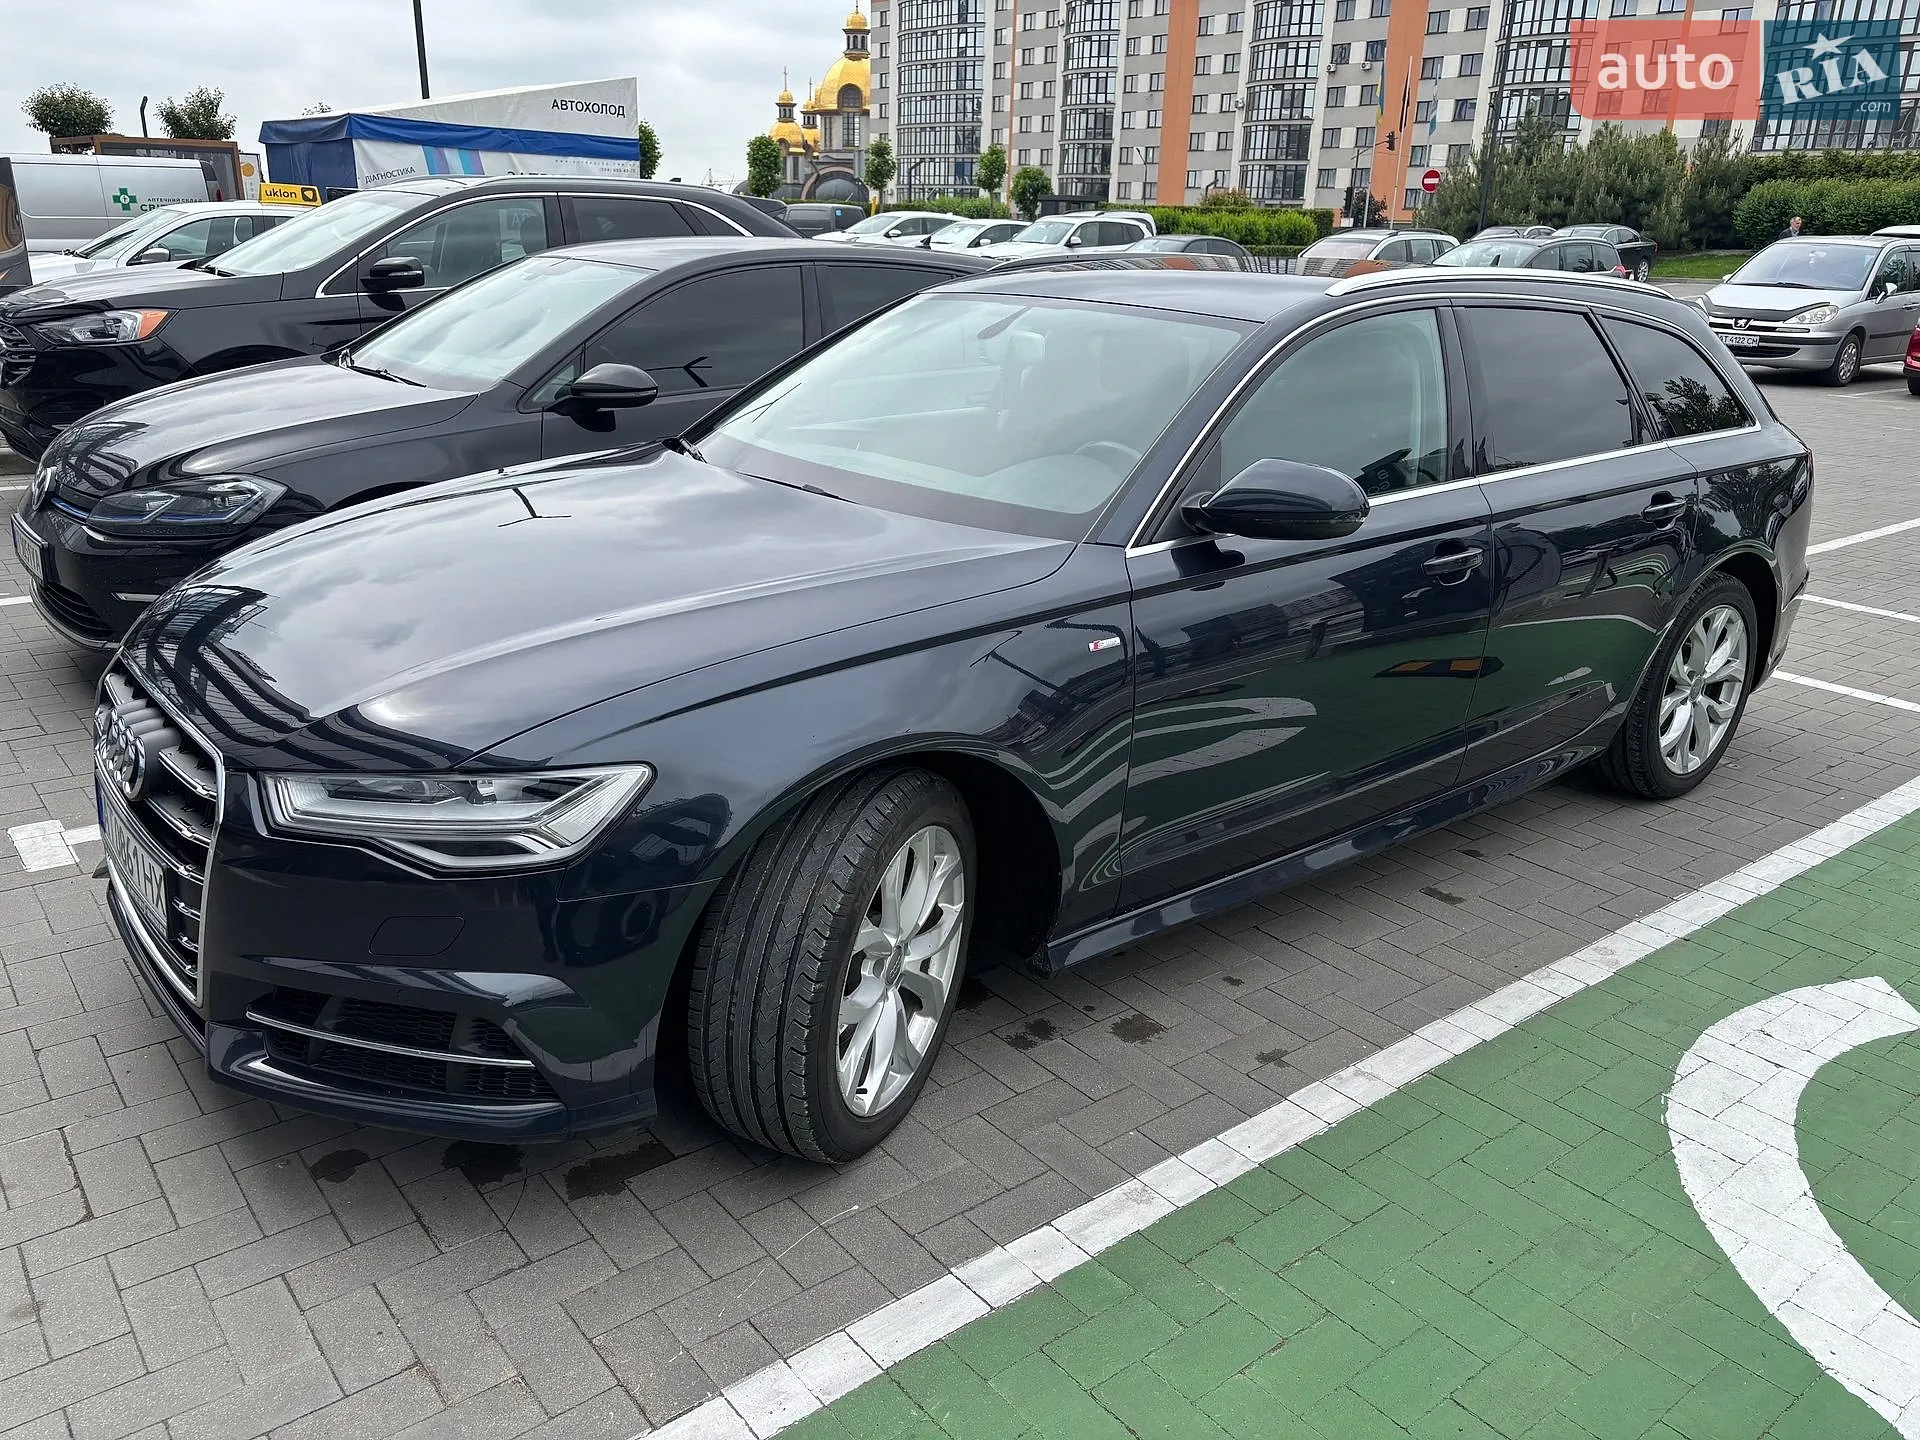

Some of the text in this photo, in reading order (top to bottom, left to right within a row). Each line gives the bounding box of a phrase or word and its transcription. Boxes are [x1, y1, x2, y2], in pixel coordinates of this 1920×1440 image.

[551, 98, 626, 119] АВТОХОЛОД
[364, 166, 416, 184] ДІАГНОСТИКА
[265, 187, 297, 199] uklon
